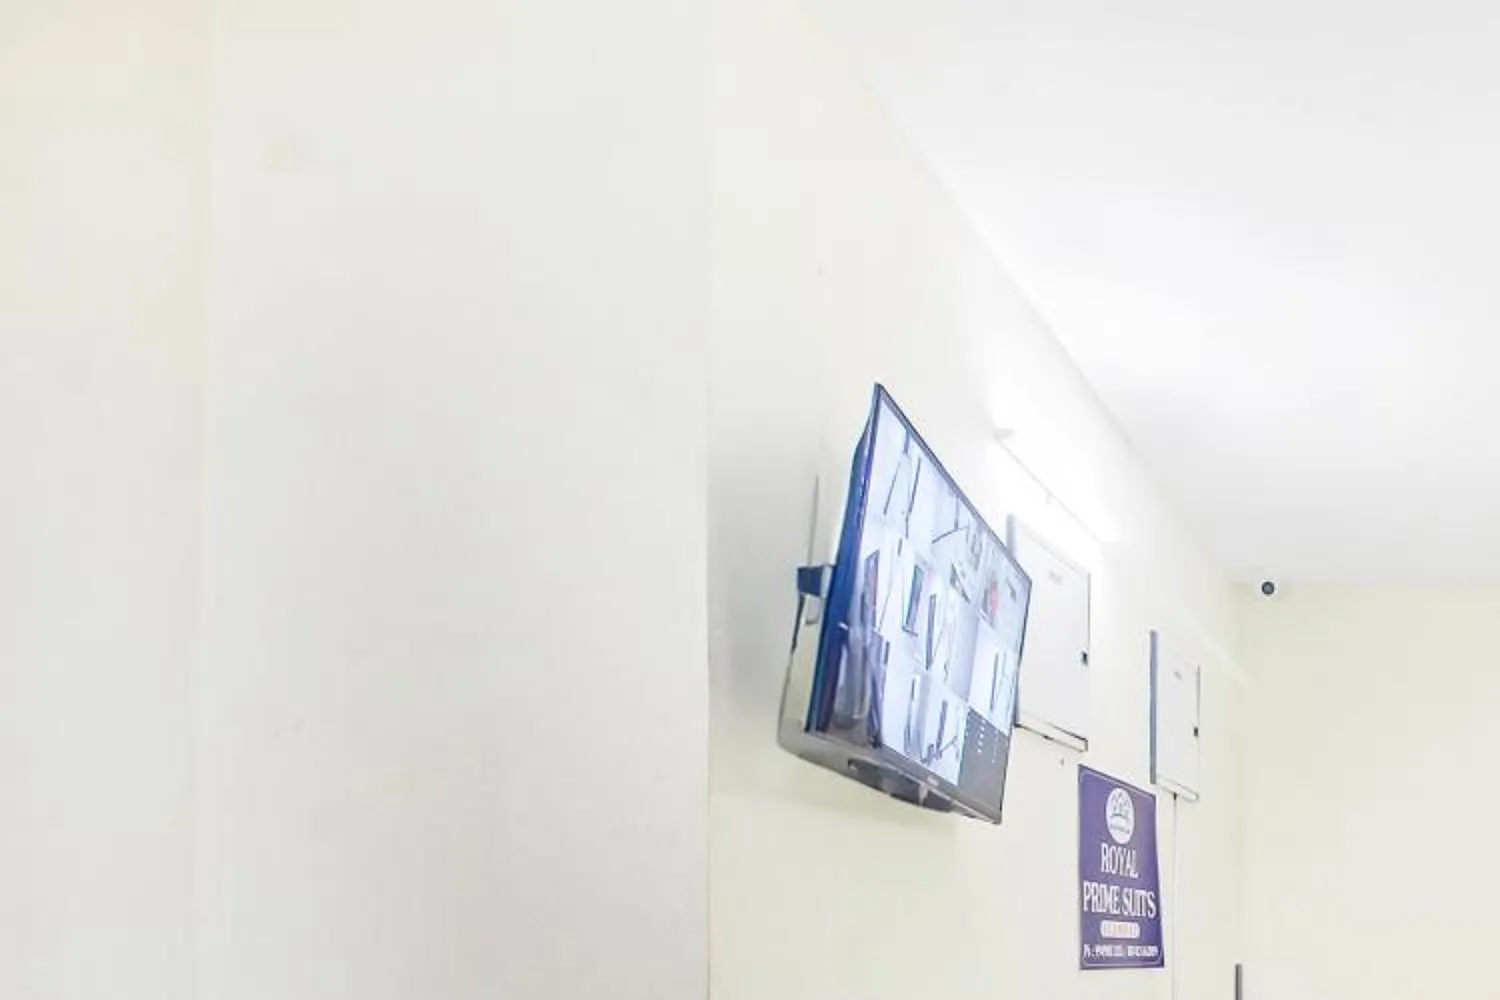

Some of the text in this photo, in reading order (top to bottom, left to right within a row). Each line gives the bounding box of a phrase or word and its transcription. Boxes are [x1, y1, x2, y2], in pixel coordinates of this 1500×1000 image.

[1101, 842, 1139, 879] ROYAL
[1083, 881, 1157, 919] PRIME SUITS
